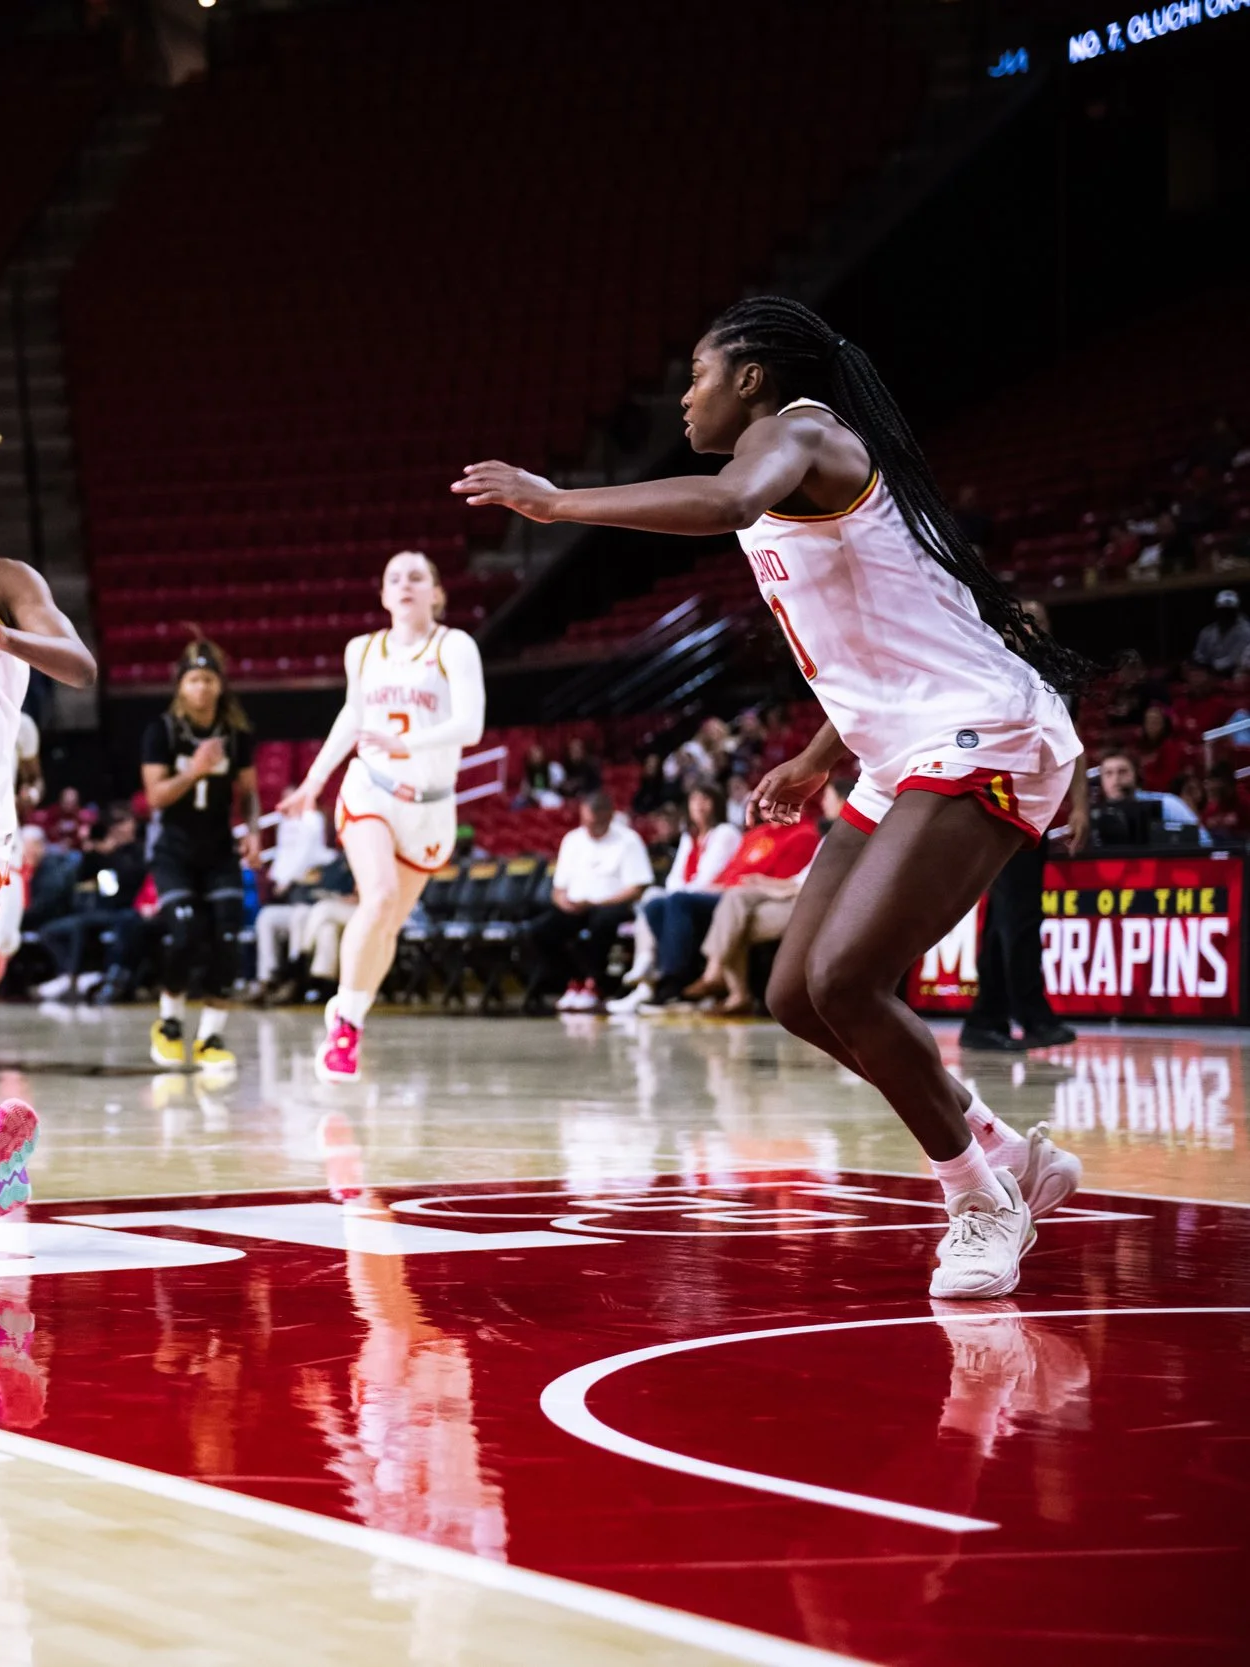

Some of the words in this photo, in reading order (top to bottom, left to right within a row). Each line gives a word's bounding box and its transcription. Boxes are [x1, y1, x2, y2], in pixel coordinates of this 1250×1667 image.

[1069, 29, 1106, 64] NO.
[194, 779, 208, 810] 1
[1097, 888, 1135, 915] OF
[1154, 886, 1216, 915] THE
